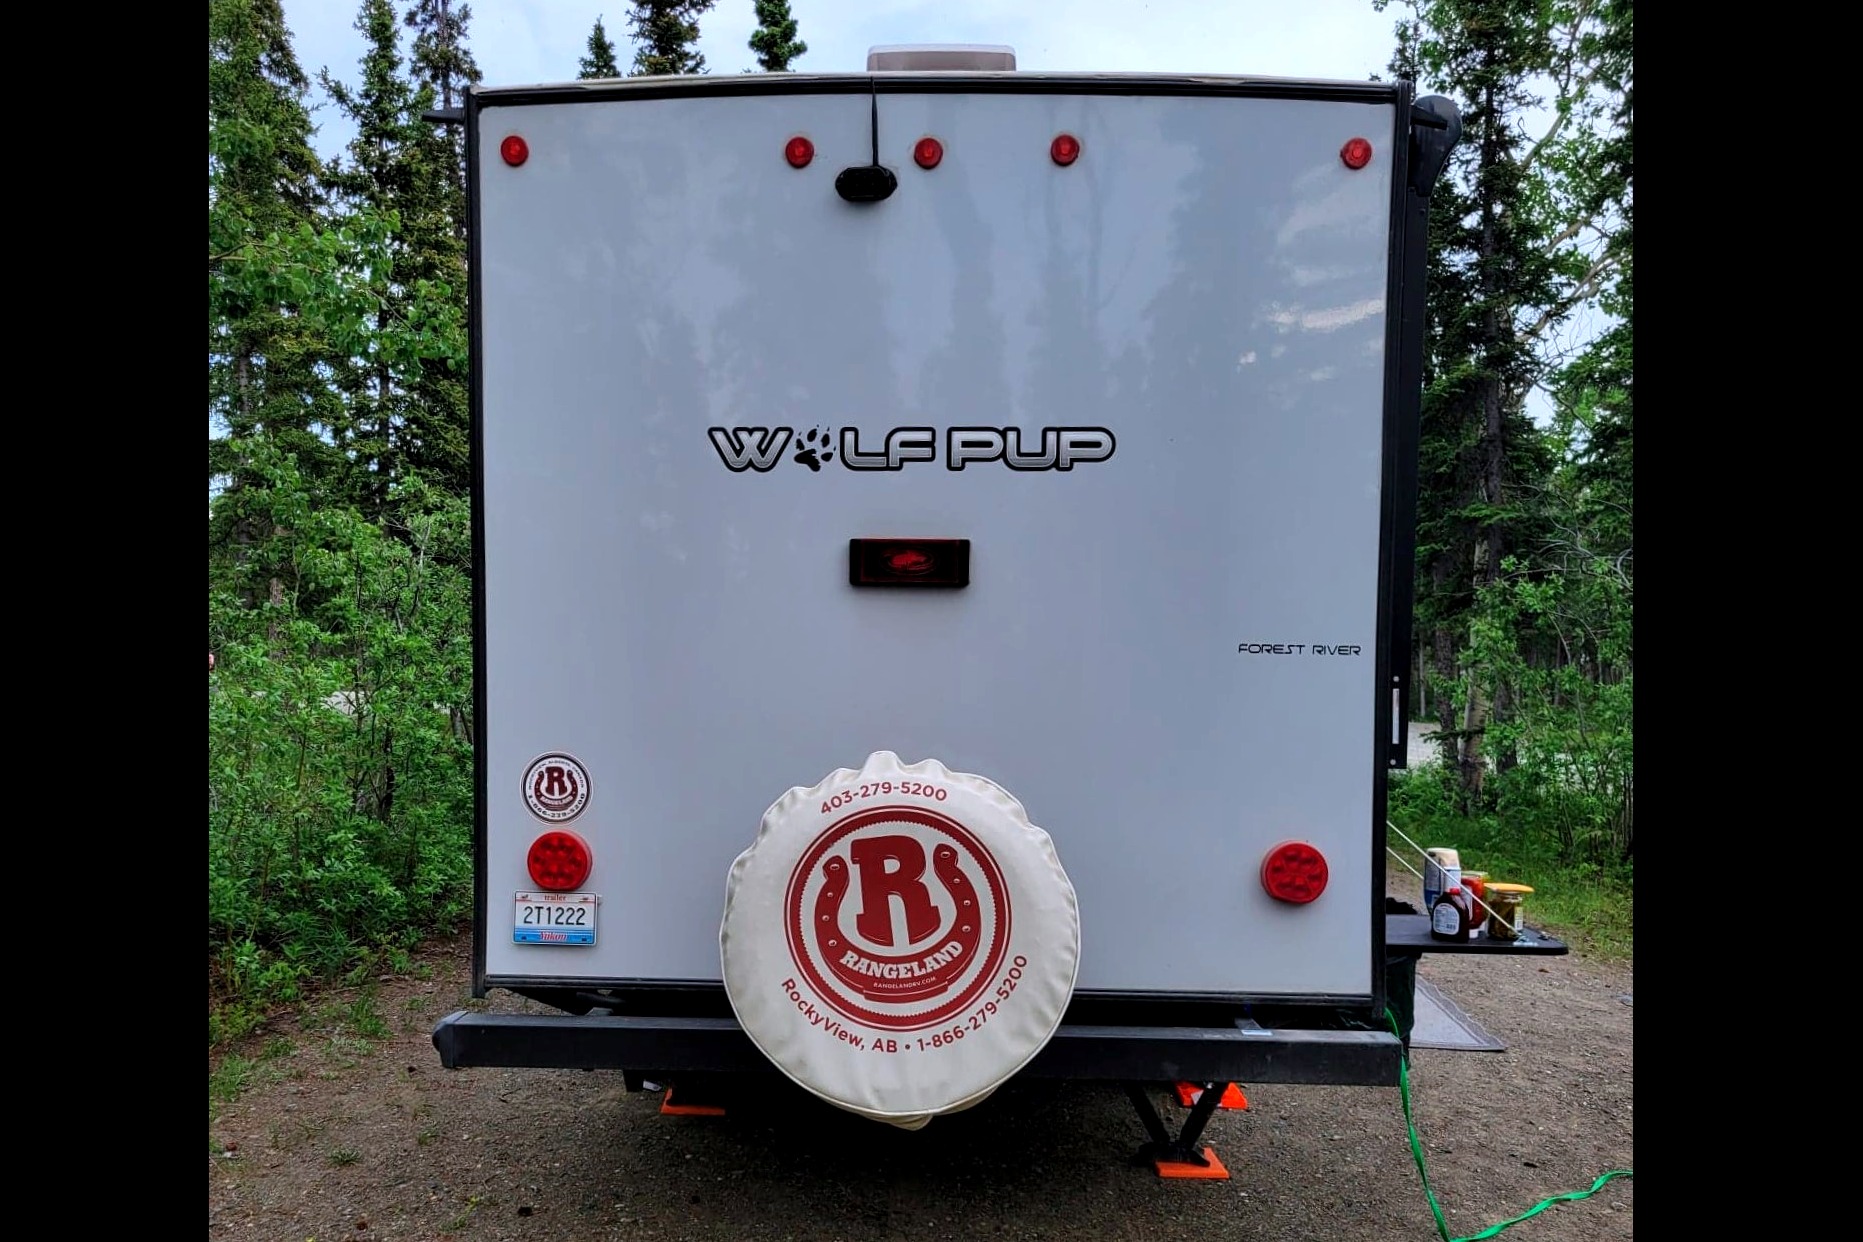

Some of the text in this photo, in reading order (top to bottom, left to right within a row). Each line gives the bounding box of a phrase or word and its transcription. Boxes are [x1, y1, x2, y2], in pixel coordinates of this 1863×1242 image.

[946, 426, 1116, 472] PUP
[1238, 643, 1362, 656] FOREST RIVER
[545, 766, 568, 797] R
[819, 781, 948, 815] 403-279-5200
[849, 834, 942, 947] R
[523, 905, 587, 926] 2T1222
[541, 931, 568, 941] Yukon
[839, 940, 963, 980] RANGELAND
[781, 977, 898, 1053] RockyView, AB
[917, 954, 1028, 1052] 1-866-279-5200
